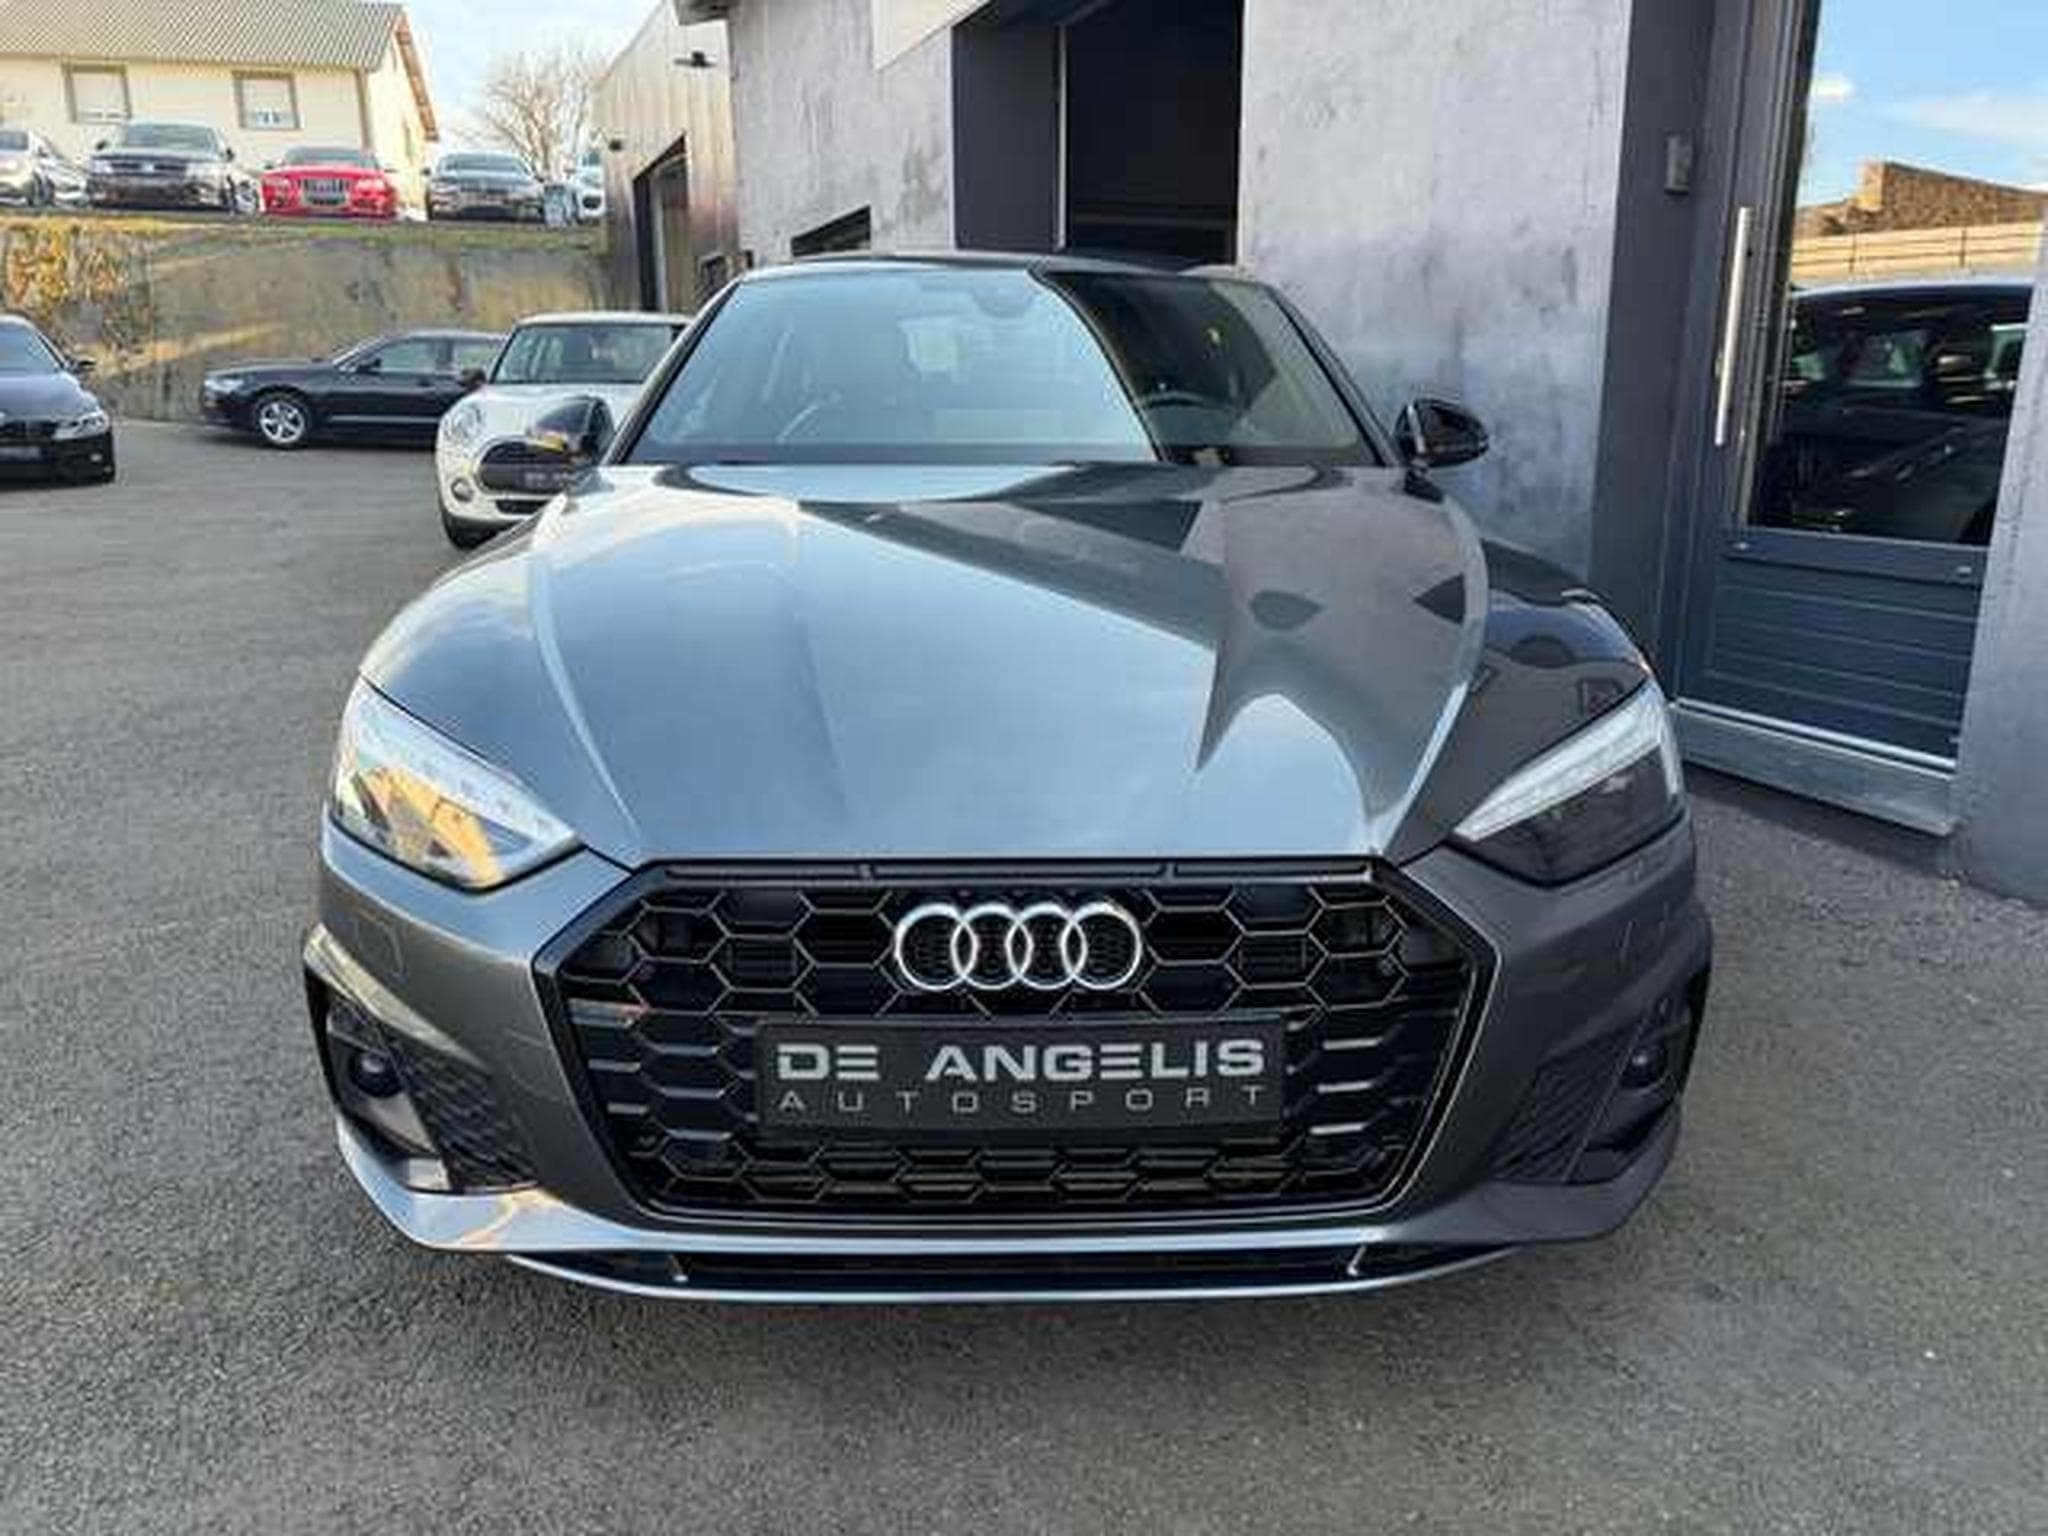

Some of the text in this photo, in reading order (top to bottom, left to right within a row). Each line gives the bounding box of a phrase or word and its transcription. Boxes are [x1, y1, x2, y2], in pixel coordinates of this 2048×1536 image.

[778, 1039, 1265, 1081] DE ANGELIS
[778, 1086, 1266, 1113] AUTOSPORT
